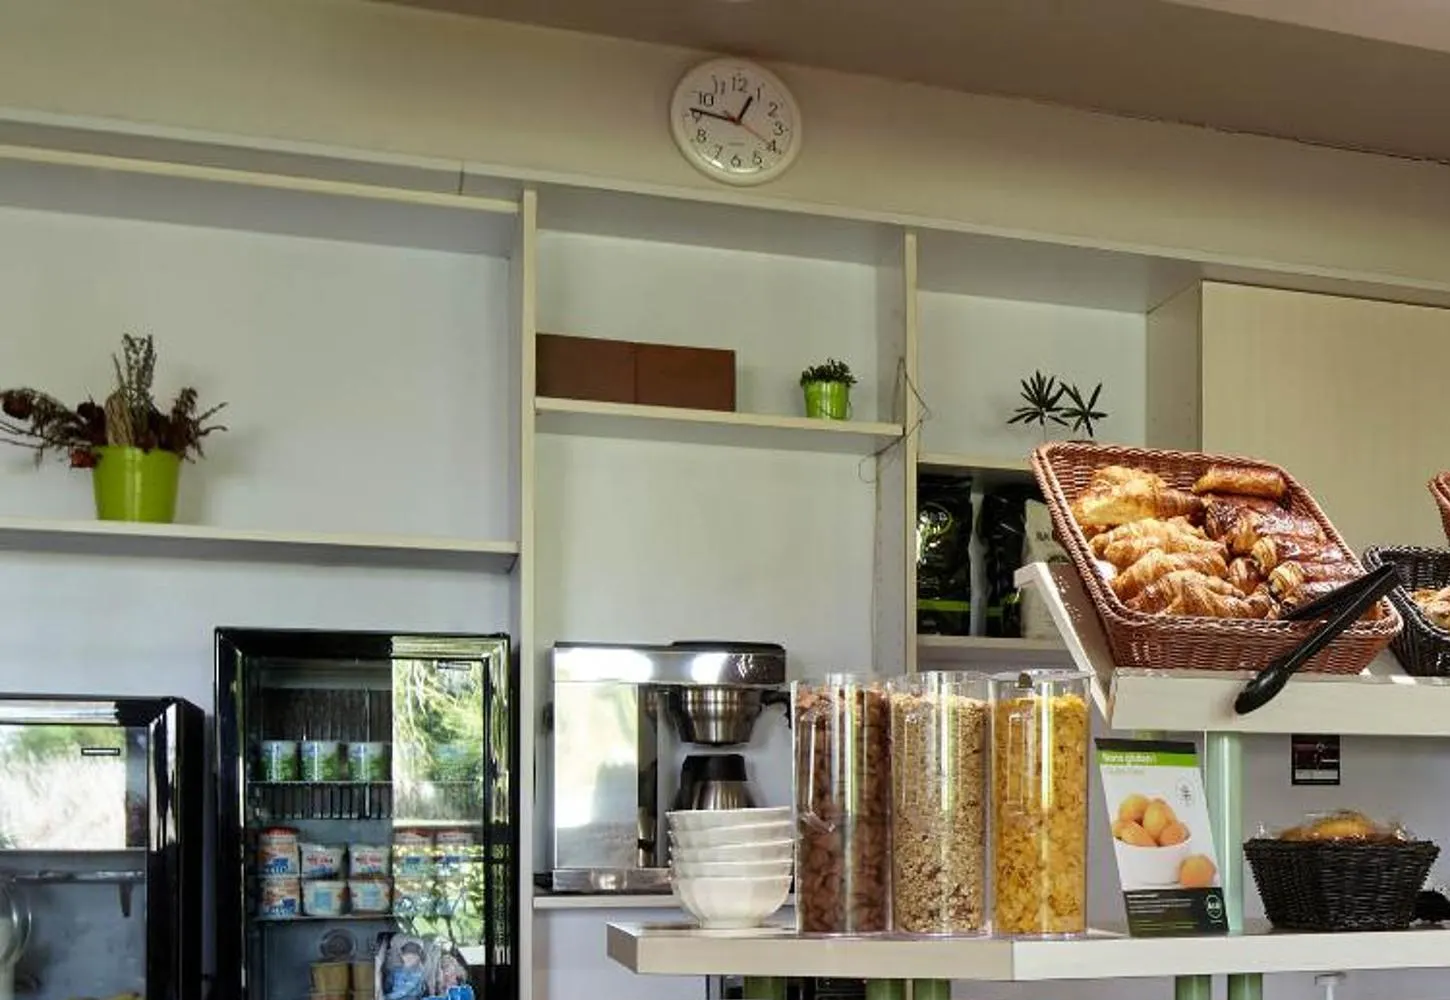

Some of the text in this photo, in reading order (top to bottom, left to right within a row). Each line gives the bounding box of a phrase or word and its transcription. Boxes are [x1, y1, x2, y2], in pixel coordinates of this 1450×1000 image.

[731, 76, 748, 93] 12
[699, 91, 714, 107] 10
[768, 102, 778, 117] 2
[696, 128, 707, 143] 8
[773, 122, 783, 136] 3
[730, 154, 741, 168] 6
